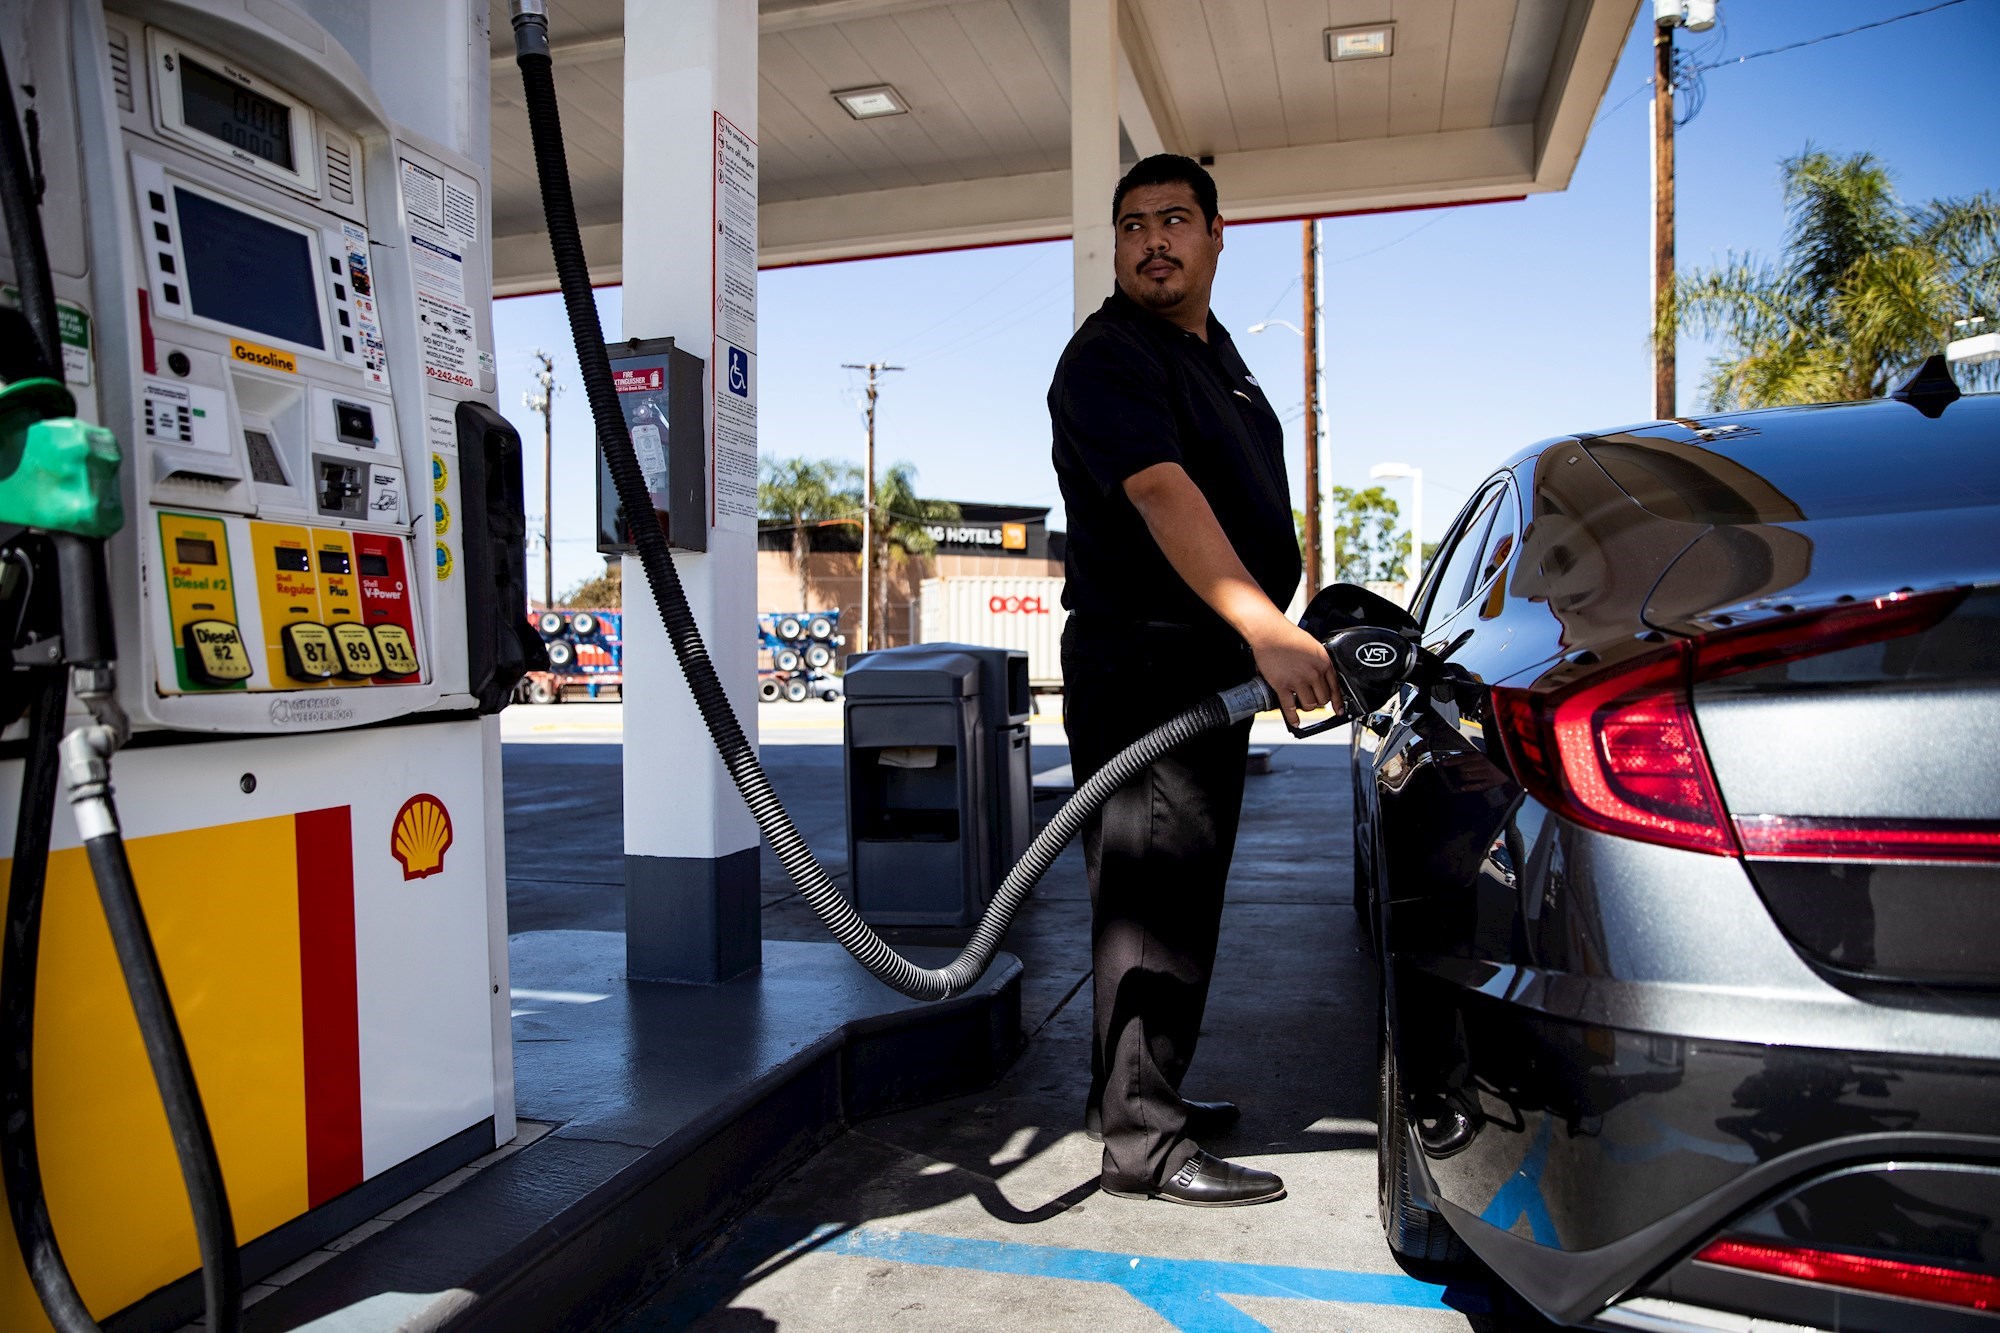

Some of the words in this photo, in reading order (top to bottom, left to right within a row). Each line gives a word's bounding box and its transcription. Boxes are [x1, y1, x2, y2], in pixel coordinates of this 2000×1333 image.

[164, 53, 174, 72] $
[231, 149, 255, 165] Gallons
[423, 336, 432, 344] DO
[432, 339, 443, 347] NOT
[444, 343, 455, 351] TOP
[455, 346, 465, 354] OFF
[235, 345, 294, 371] Gasoline
[426, 350, 441, 359] NOZZLE
[614, 377, 646, 386] XTINGUISHER
[623, 371, 633, 379] FIRE
[946, 527, 1002, 545] HOTELS
[172, 567, 192, 576] Shell
[275, 574, 292, 582] Shell
[173, 577, 210, 590] Diesel
[213, 578, 227, 591] #2
[328, 577, 344, 585] Shell
[363, 579, 379, 588] Shell
[276, 583, 315, 596] Regular
[329, 585, 349, 597] Plus
[364, 588, 401, 600] V-Power
[989, 596, 1049, 613] OOCL
[196, 628, 239, 644] Diesel
[213, 645, 234, 660] #2
[304, 642, 328, 661] 87
[349, 641, 371, 661] 89
[385, 641, 409, 661] 91
[1363, 647, 1389, 662] VST
[292, 697, 342, 710] GILBARCO
[295, 711, 330, 723] VEEDER
